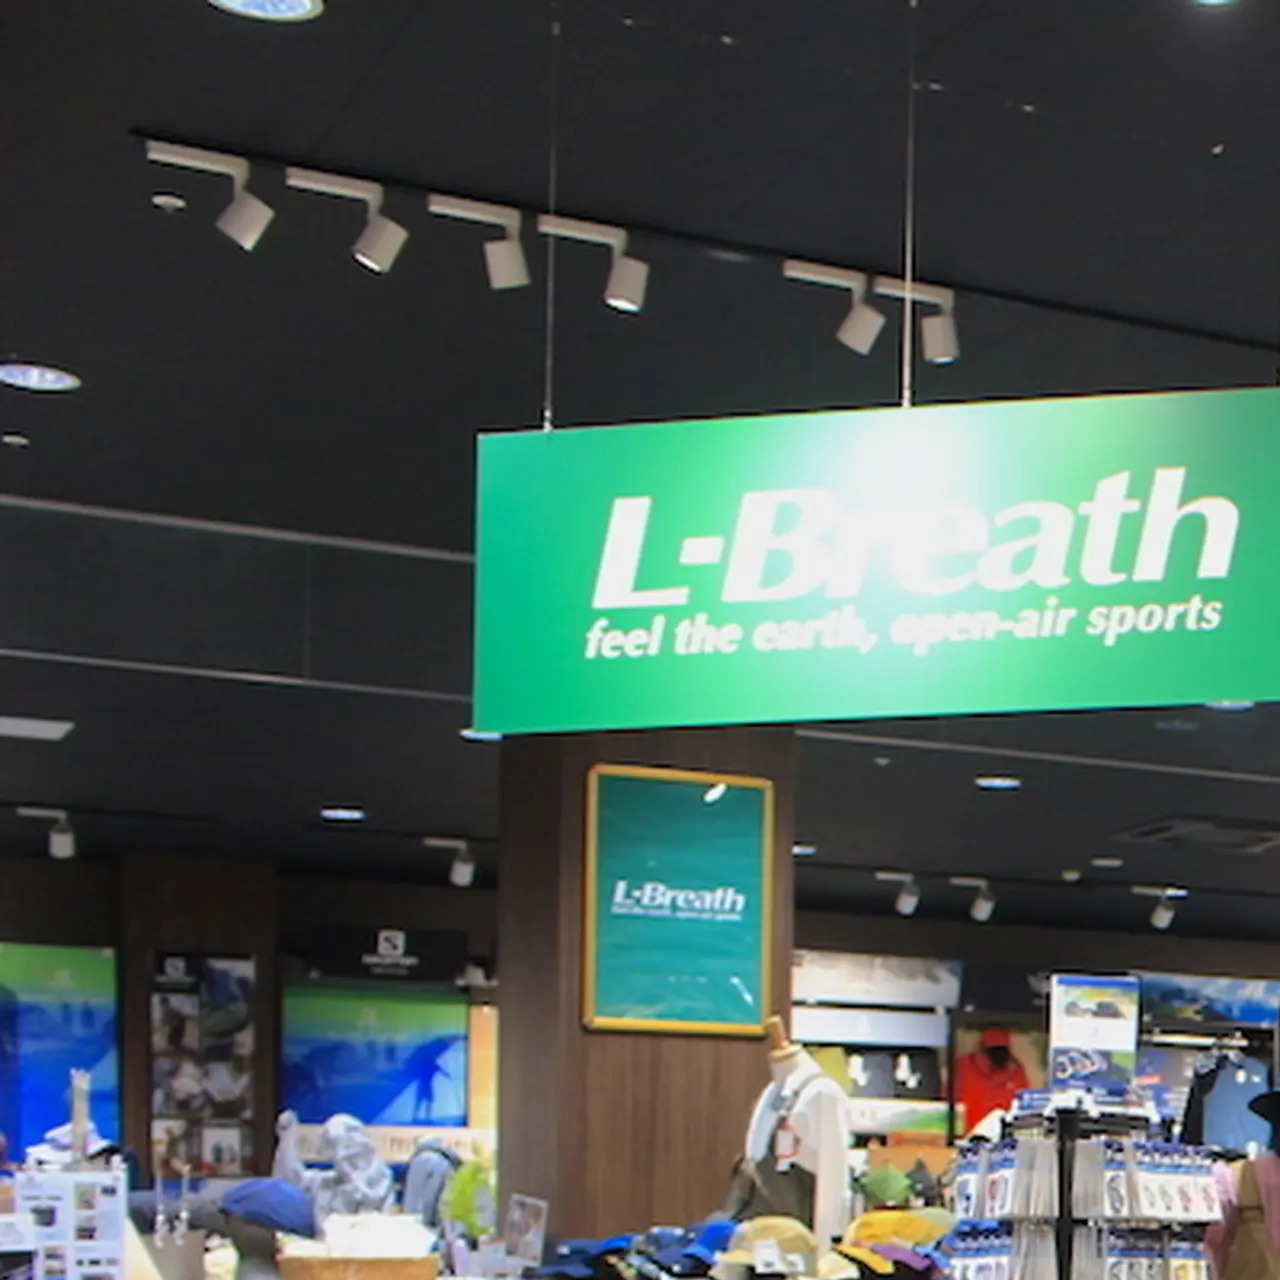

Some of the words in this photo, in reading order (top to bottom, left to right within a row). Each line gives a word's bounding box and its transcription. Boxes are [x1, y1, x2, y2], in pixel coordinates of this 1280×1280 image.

[591, 466, 1241, 609] L-Breath
[584, 614, 666, 659] feel
[674, 611, 743, 655] the
[752, 603, 878, 655] earth,
[890, 595, 1078, 657] open-air
[1086, 593, 1224, 648] sports
[612, 879, 747, 913] L-Breath
